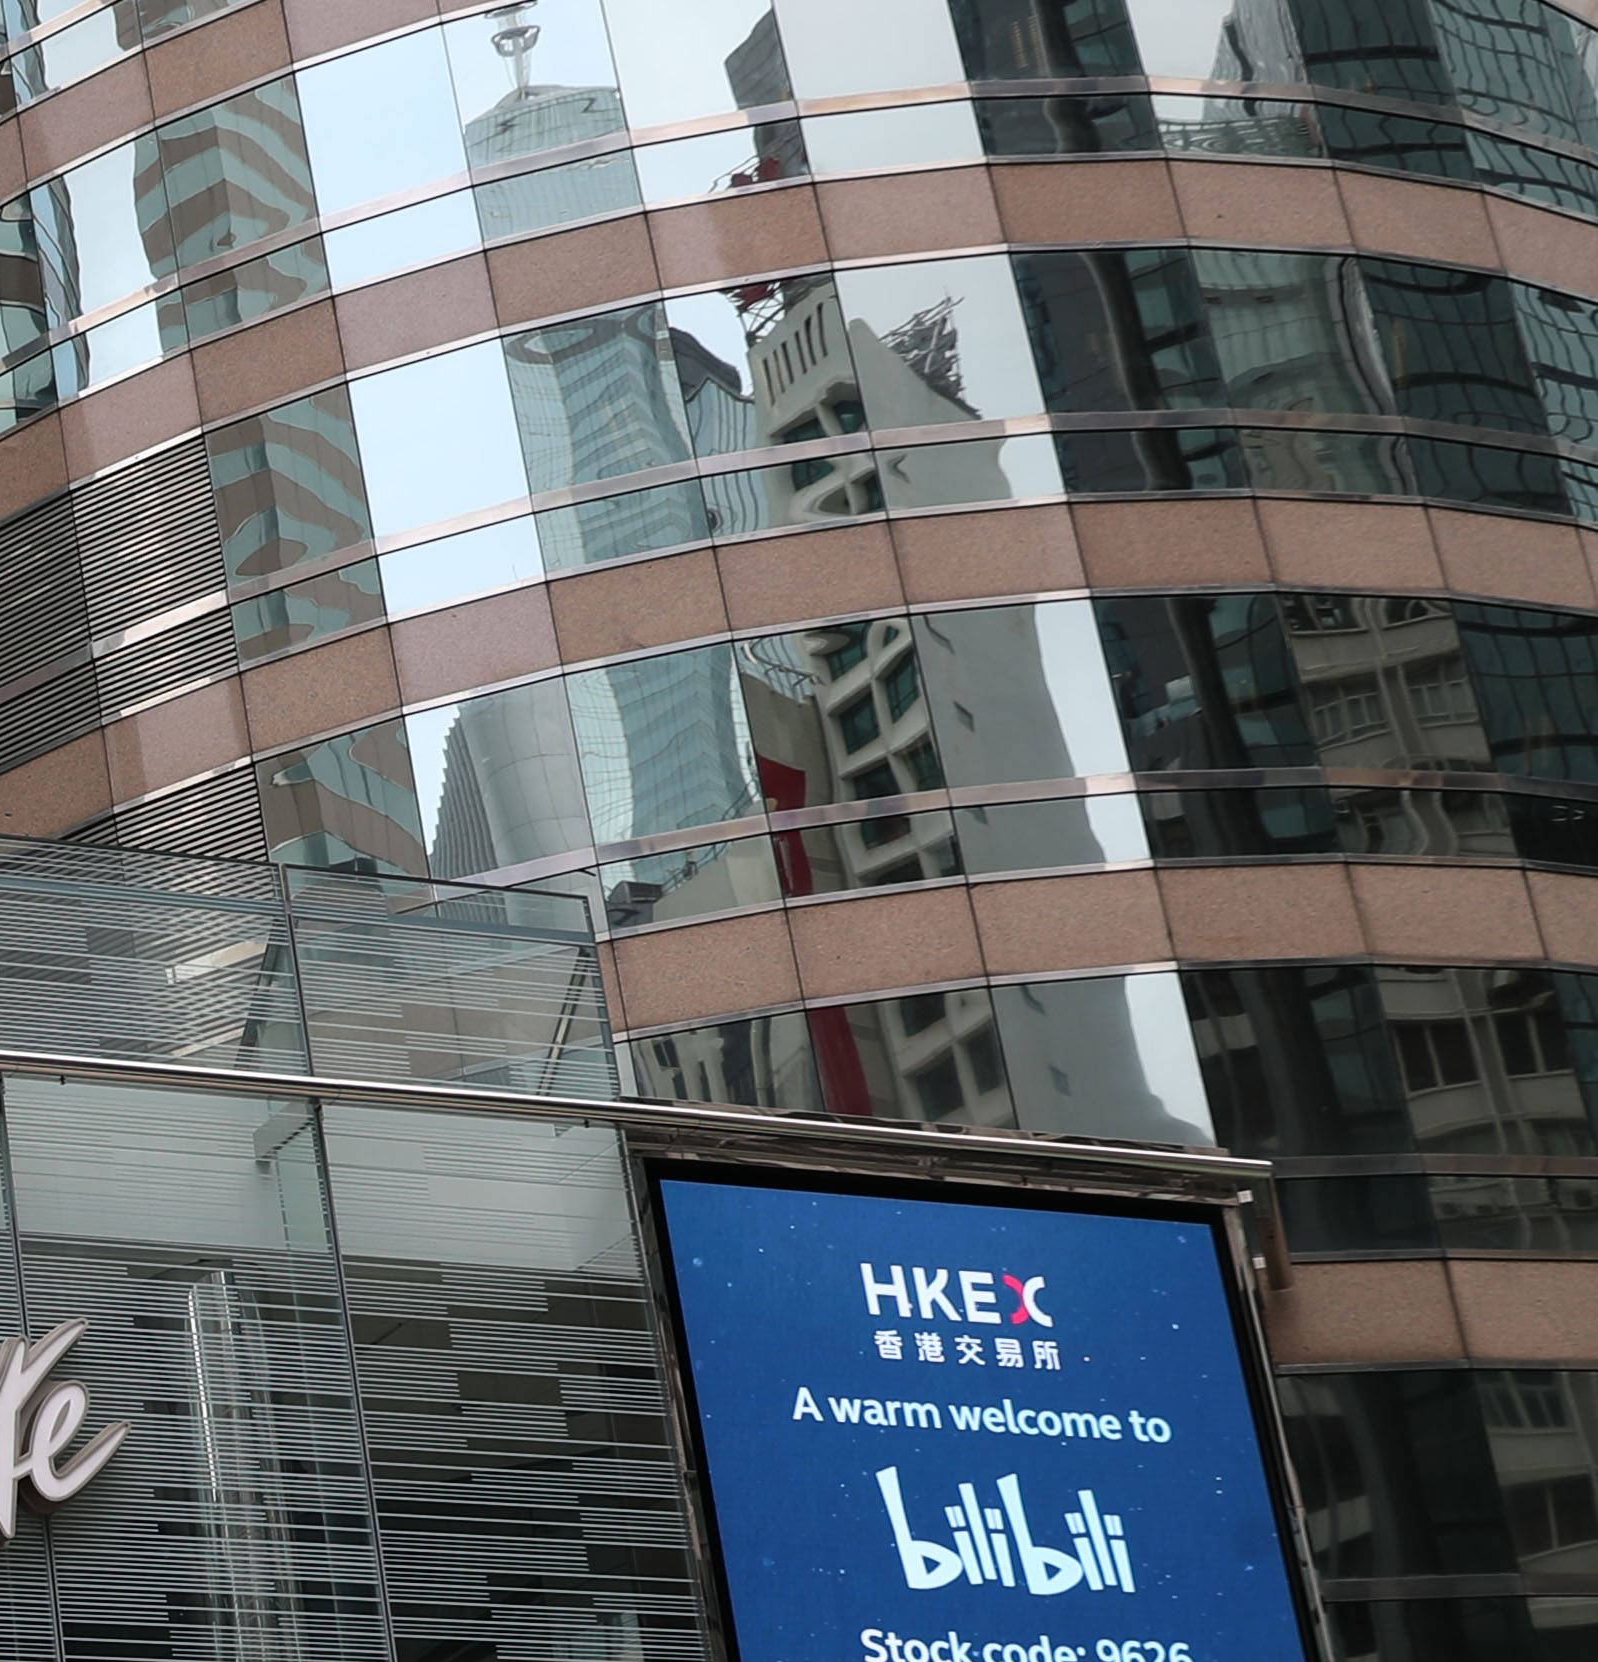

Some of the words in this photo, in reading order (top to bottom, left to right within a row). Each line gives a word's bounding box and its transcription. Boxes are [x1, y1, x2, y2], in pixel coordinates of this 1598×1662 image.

[875, 1330, 1060, 1369] 香港交易所
[793, 1387, 823, 1421] A
[828, 1398, 941, 1428] warm
[949, 1399, 1121, 1439] welcome
[1129, 1411, 1170, 1442] to
[876, 1467, 1134, 1594] bilibili
